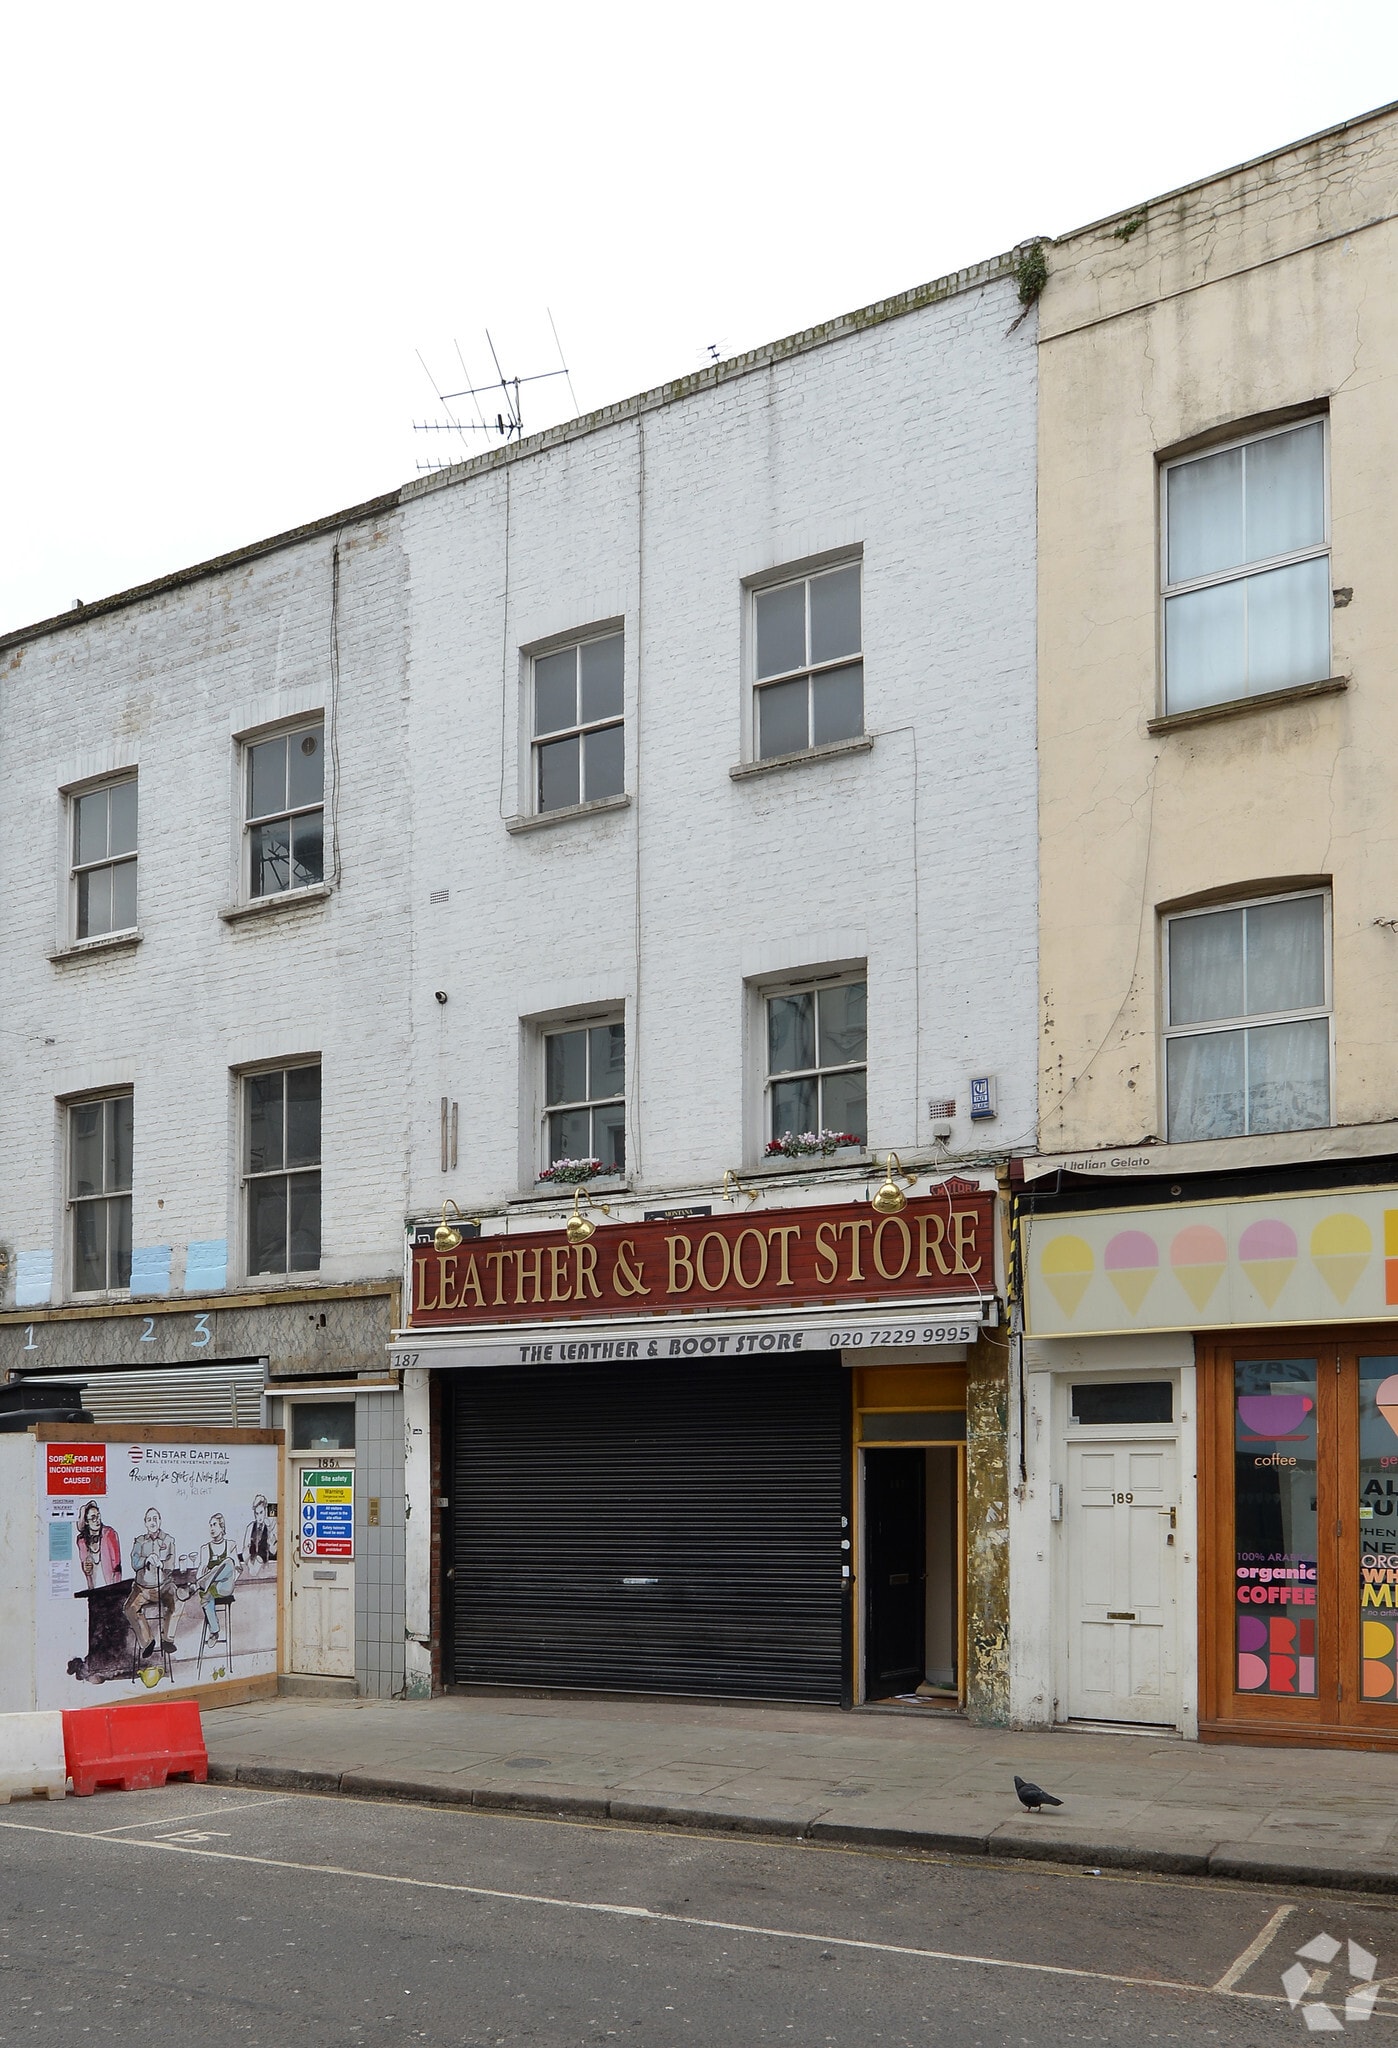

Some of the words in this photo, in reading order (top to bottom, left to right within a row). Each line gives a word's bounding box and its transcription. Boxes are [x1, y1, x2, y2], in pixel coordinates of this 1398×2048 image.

[1070, 1160, 1106, 1170] Italian
[1111, 1158, 1150, 1167] Gelato
[416, 1243, 602, 1310] LEATHER
[612, 1240, 651, 1297] &
[666, 1226, 800, 1294] BOOT
[814, 1210, 982, 1284] STORE
[24, 1324, 38, 1350] 1
[140, 1318, 157, 1342] 2
[191, 1314, 211, 1347] 3
[830, 1331, 862, 1346] 020
[870, 1328, 914, 1345] 7229
[922, 1326, 970, 1344] 9995
[520, 1345, 554, 1362] THE
[560, 1340, 640, 1361] LEATHER
[647, 1340, 658, 1356] &
[668, 1336, 730, 1357] BOOT
[736, 1332, 803, 1353] STORE
[394, 1354, 420, 1366] 187
[146, 1449, 186, 1458] ENSTAR
[190, 1450, 230, 1460] CAPITAL
[1254, 1452, 1296, 1466] coffee
[1111, 1493, 1133, 1504] 189
[1236, 1564, 1316, 1582] organic
[1237, 1586, 1316, 1605] COFFEE
[1239, 1616, 1315, 1654] DRI
[1238, 1652, 1315, 1694] DRI
